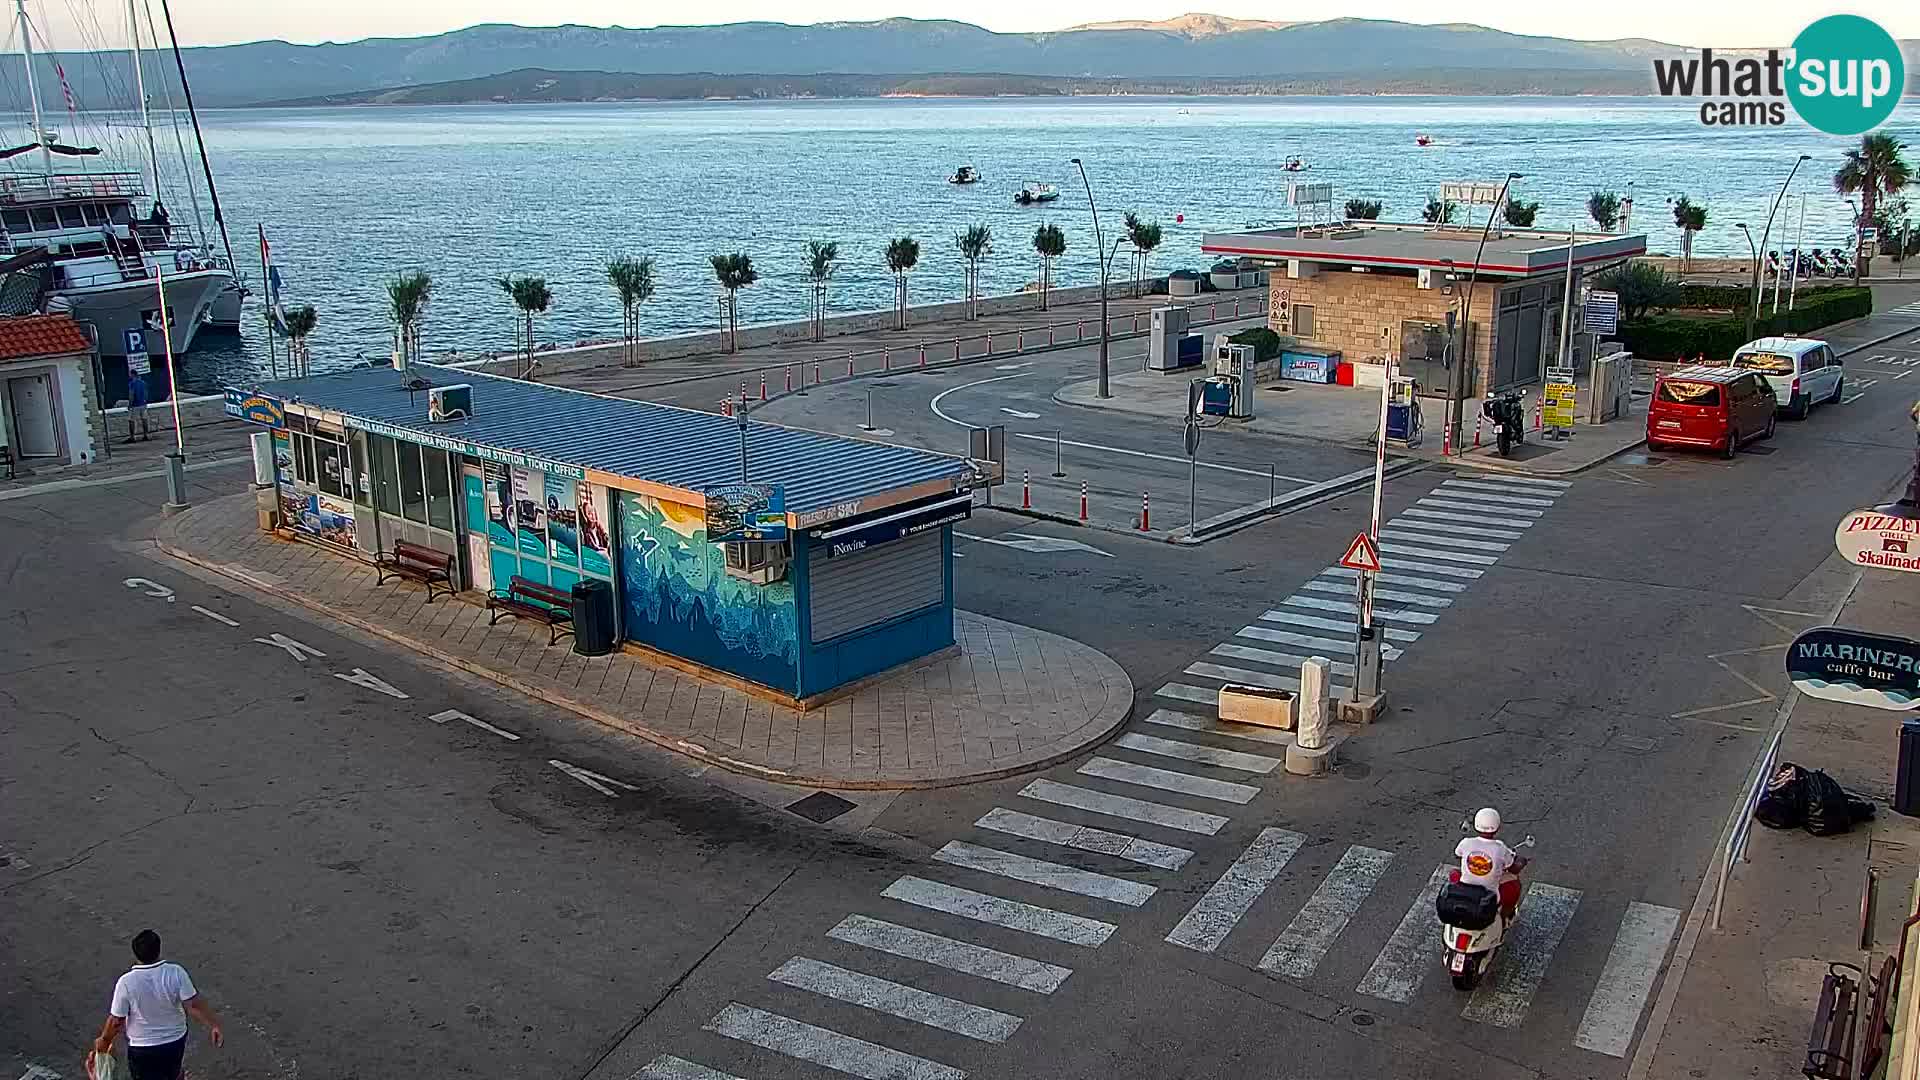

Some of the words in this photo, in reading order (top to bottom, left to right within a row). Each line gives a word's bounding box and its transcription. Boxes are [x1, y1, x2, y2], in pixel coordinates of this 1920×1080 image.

[395, 427, 435, 446] AUTOBUSNA
[435, 438, 467, 453] POSTAJA
[477, 446, 491, 458] BUS
[492, 450, 525, 466] STATION
[527, 457, 553, 472] TICKET
[554, 465, 581, 478] OFFICE
[1880, 531, 1914, 541] GRILL
[1827, 663, 1864, 676] caffe
[1868, 666, 1895, 681] bar
